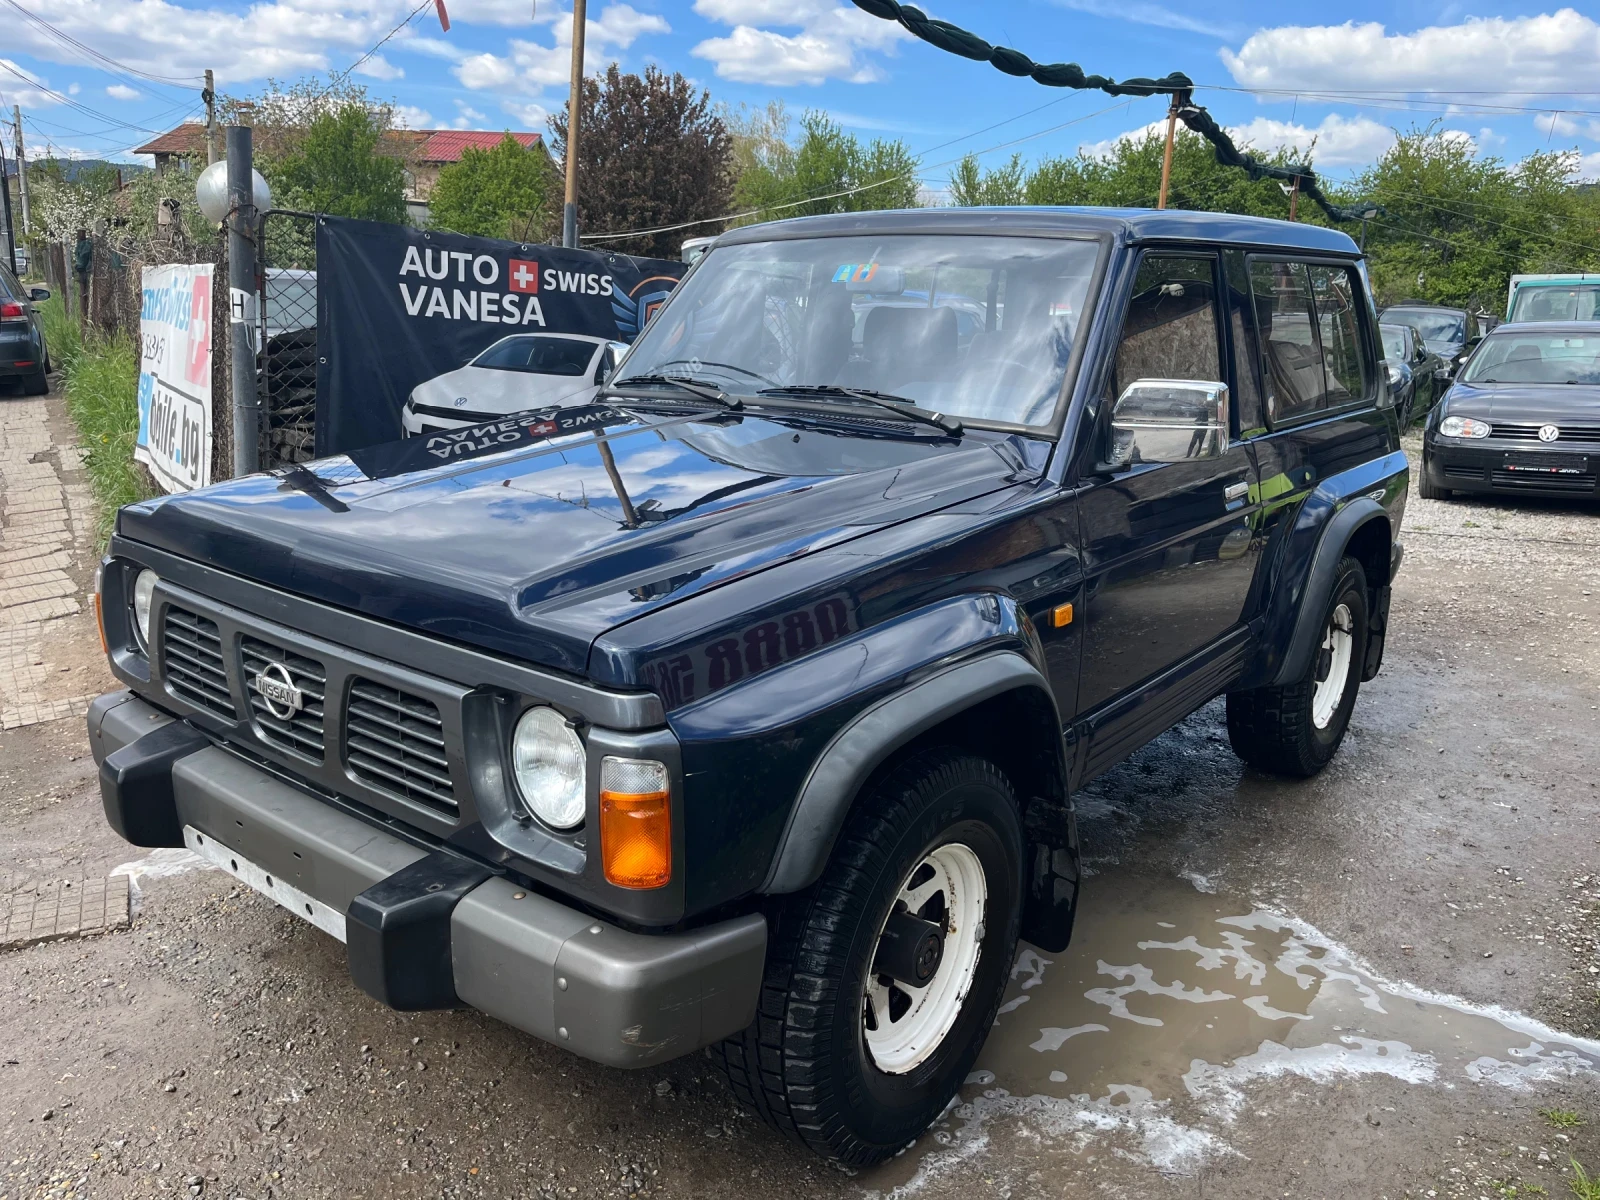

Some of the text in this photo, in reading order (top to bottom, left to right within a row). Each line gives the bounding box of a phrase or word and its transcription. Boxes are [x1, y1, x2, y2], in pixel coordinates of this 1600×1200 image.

[399, 245, 613, 297] AUTO SWISS
[399, 283, 547, 327] VANESA
[150, 390, 200, 482] obile.bg
[257, 679, 295, 705] NISSAN
